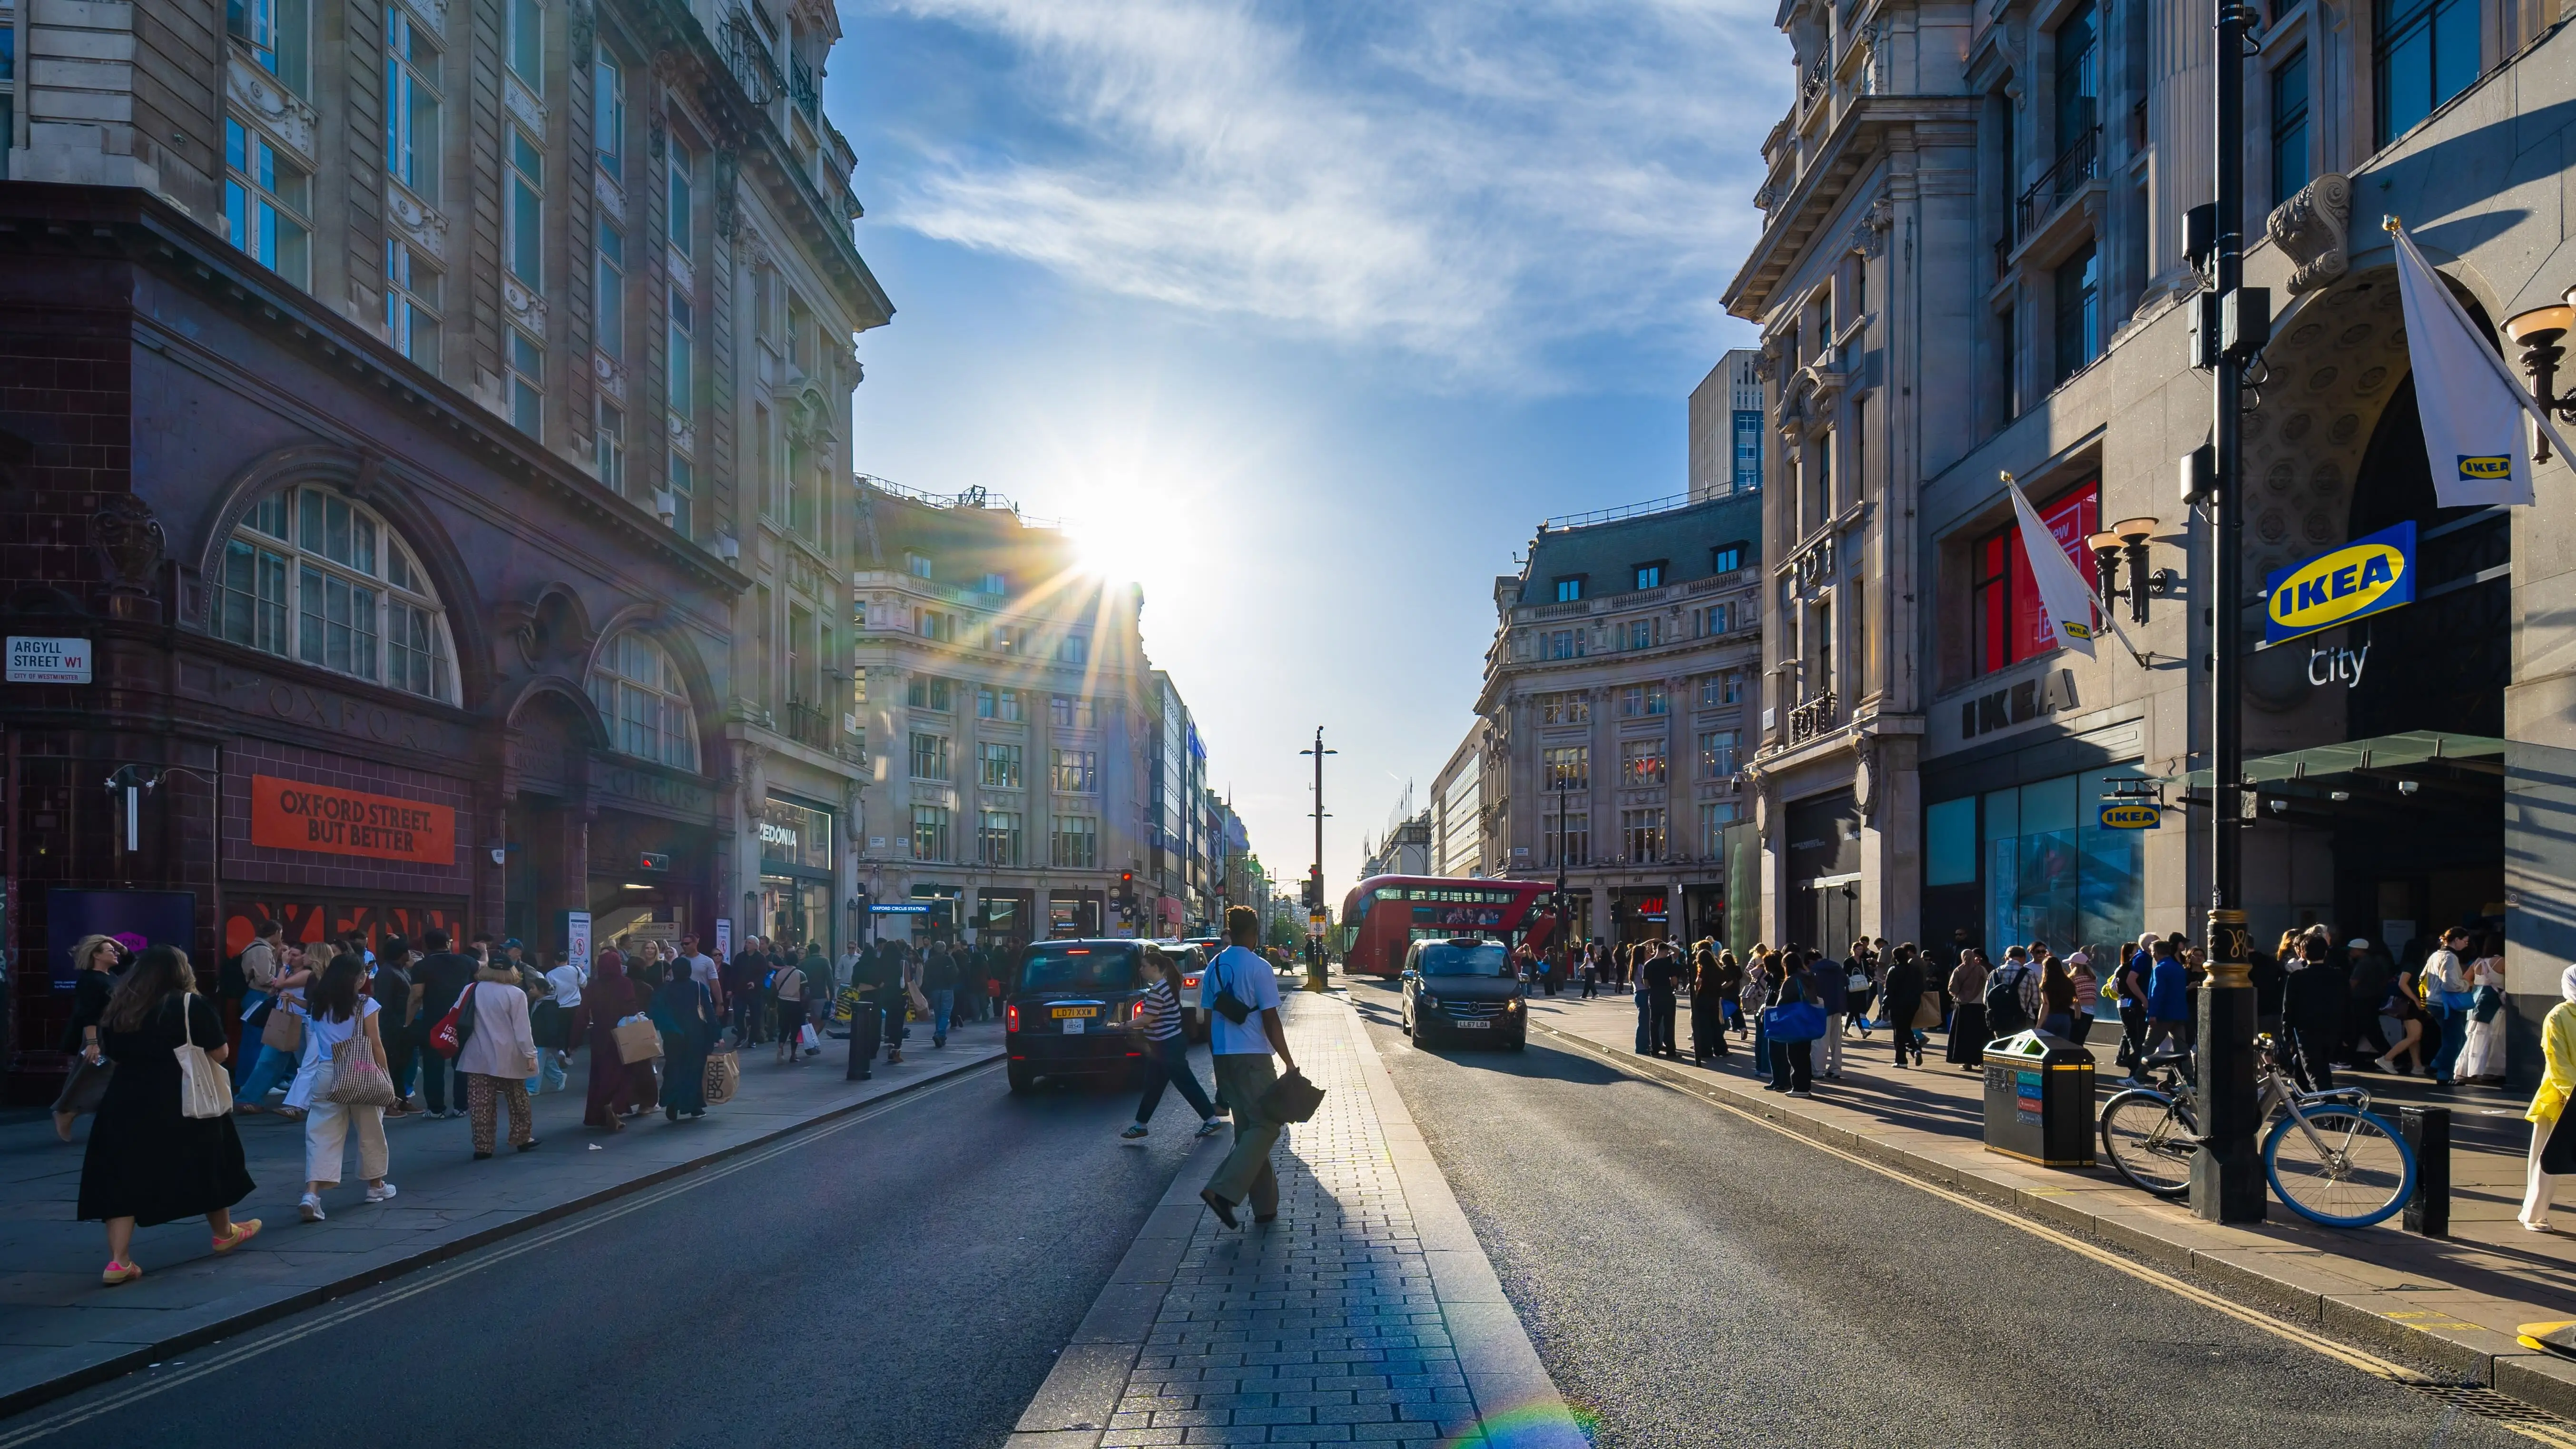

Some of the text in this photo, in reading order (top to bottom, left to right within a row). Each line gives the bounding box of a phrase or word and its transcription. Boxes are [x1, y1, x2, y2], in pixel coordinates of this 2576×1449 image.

[2466, 461, 2509, 473] IKEA
[2051, 522, 2070, 542] ew
[2280, 553, 2394, 618] IKEA
[14, 641, 62, 653] ARGYLL
[14, 655, 82, 668] STREET W1
[2308, 646, 2368, 688] City
[1962, 668, 2081, 740] IKEA
[270, 685, 443, 751] OXFORD
[280, 790, 433, 834] OXFORD STREET,
[2107, 811, 2156, 822] IKEA
[308, 818, 414, 852] BUT BETTER
[1056, 1008, 1074, 1017] LD71
